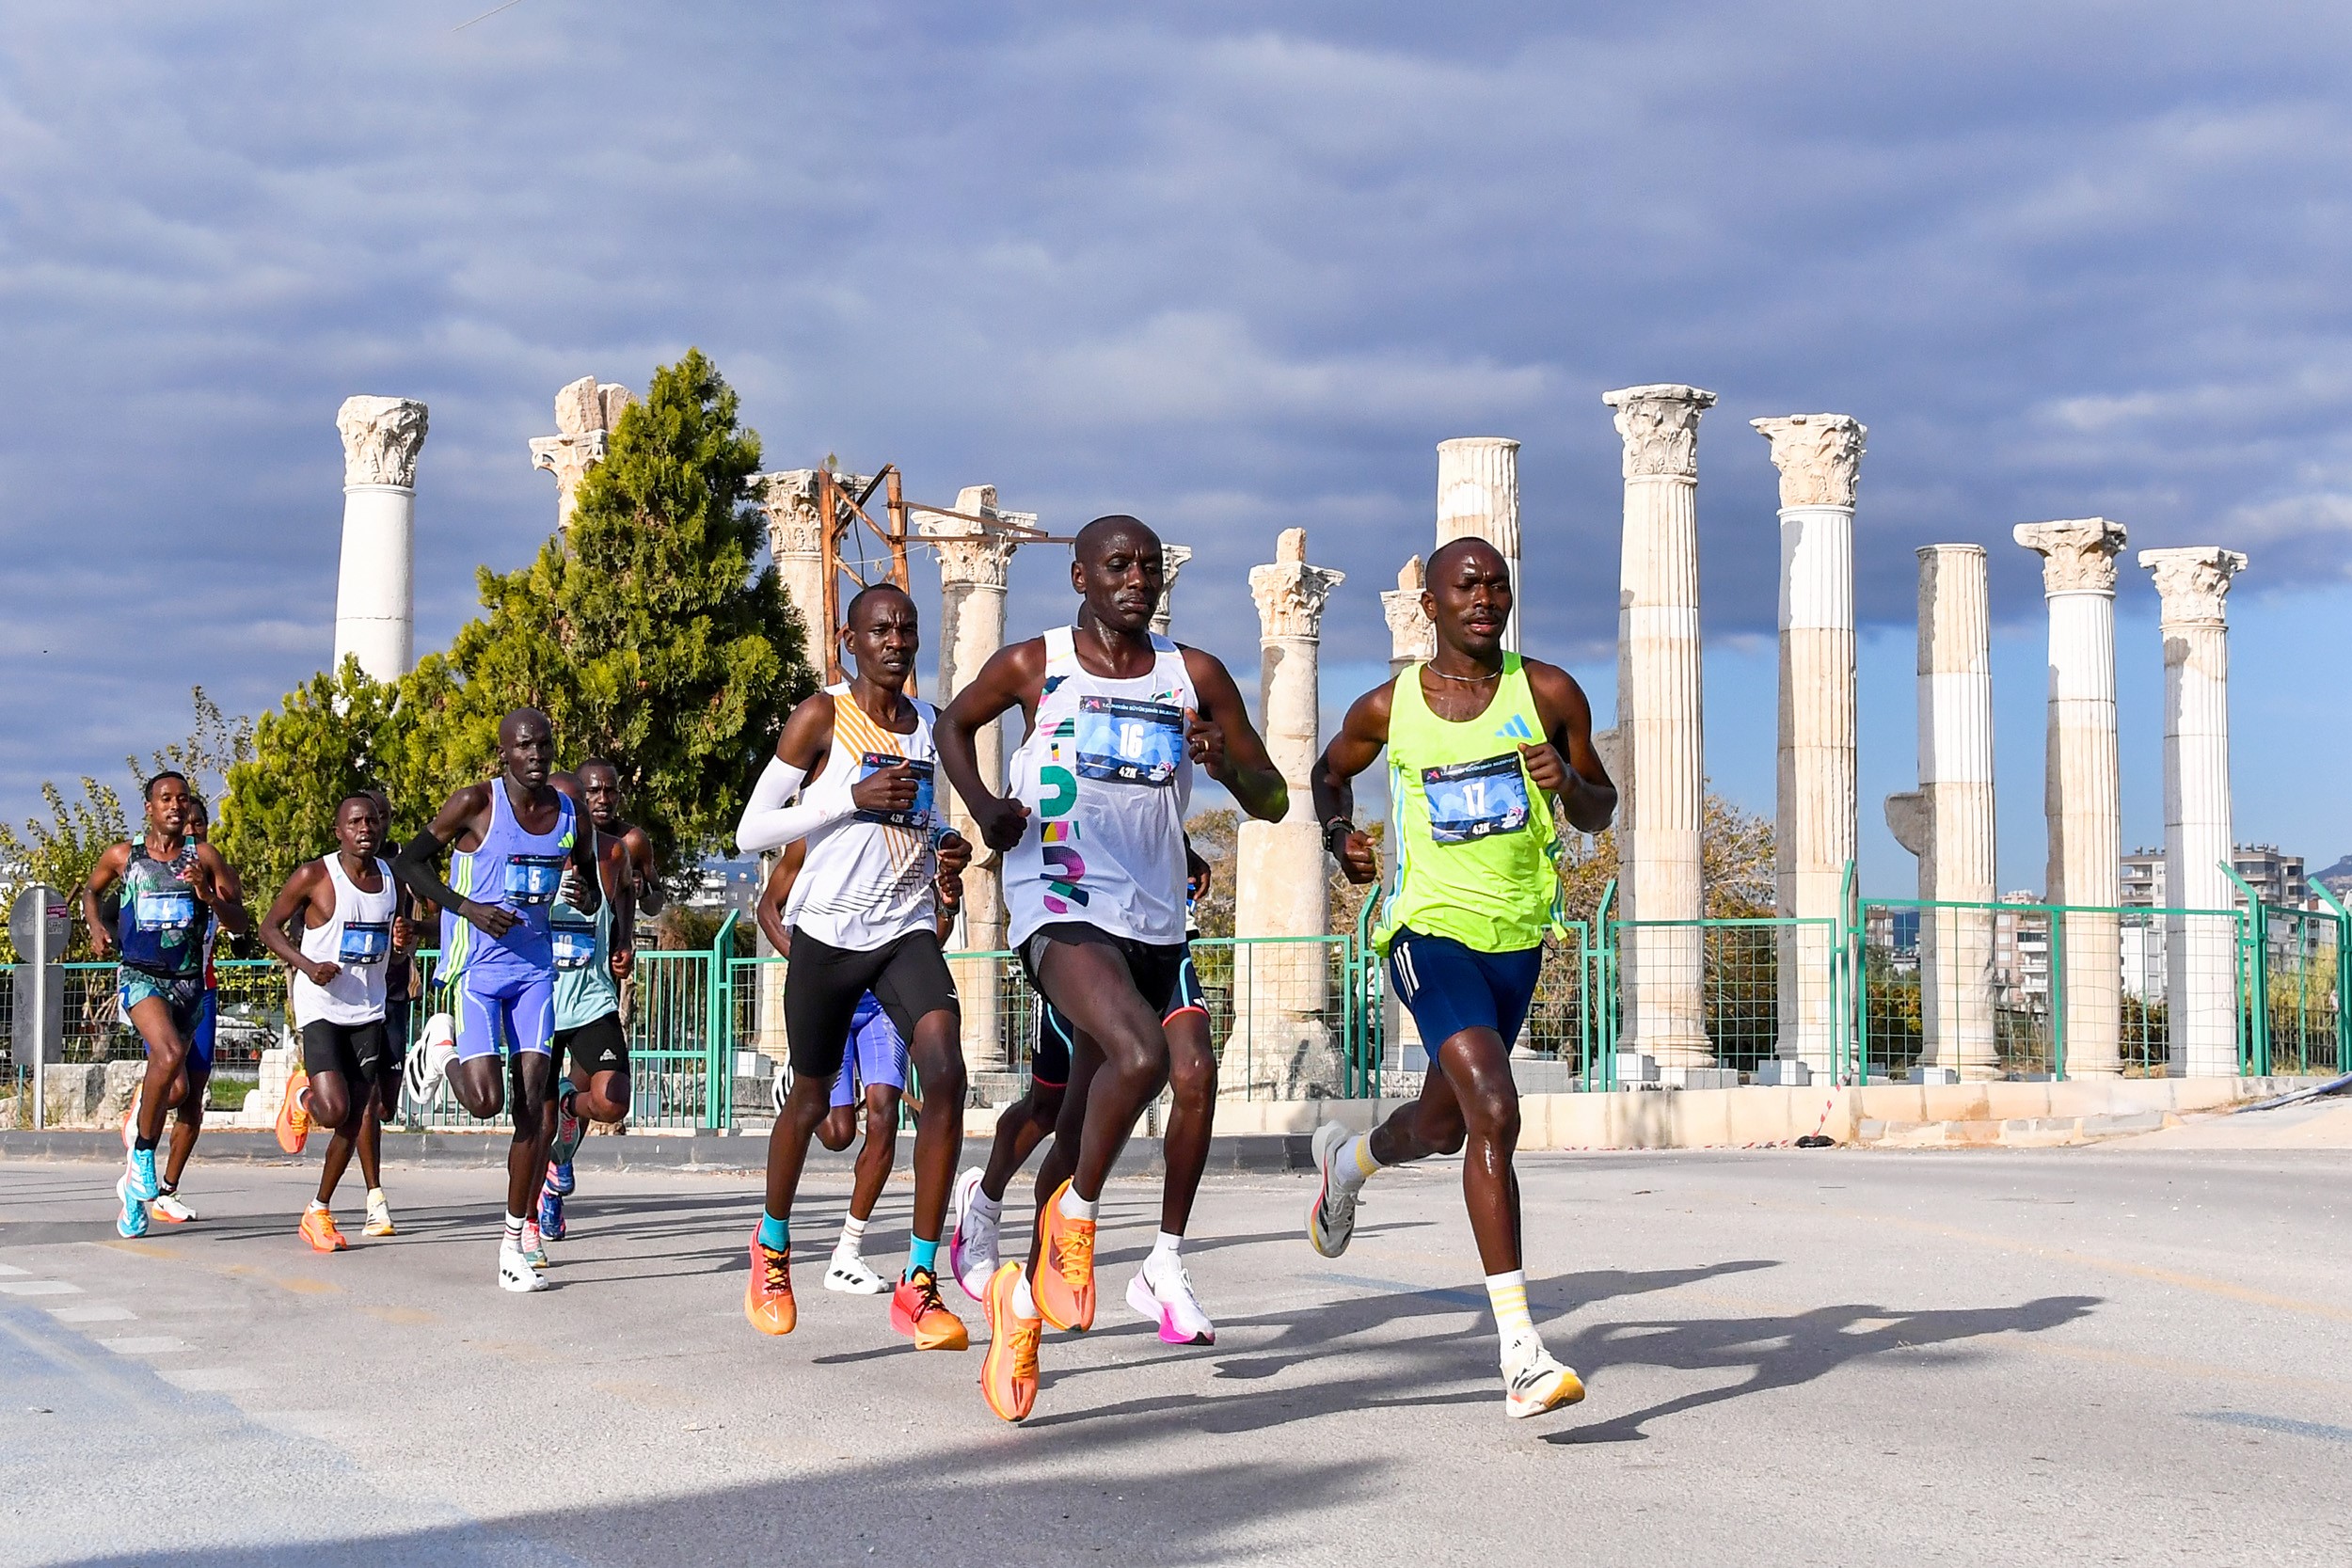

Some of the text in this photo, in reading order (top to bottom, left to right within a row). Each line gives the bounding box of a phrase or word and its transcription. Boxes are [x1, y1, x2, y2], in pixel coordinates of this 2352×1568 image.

[1120, 722, 1144, 759] 16
[1118, 766, 1138, 779] 42K
[1462, 782, 1486, 816] 17
[889, 813, 905, 824] 42K
[1471, 821, 1490, 835] 42K
[530, 869, 542, 892] 5
